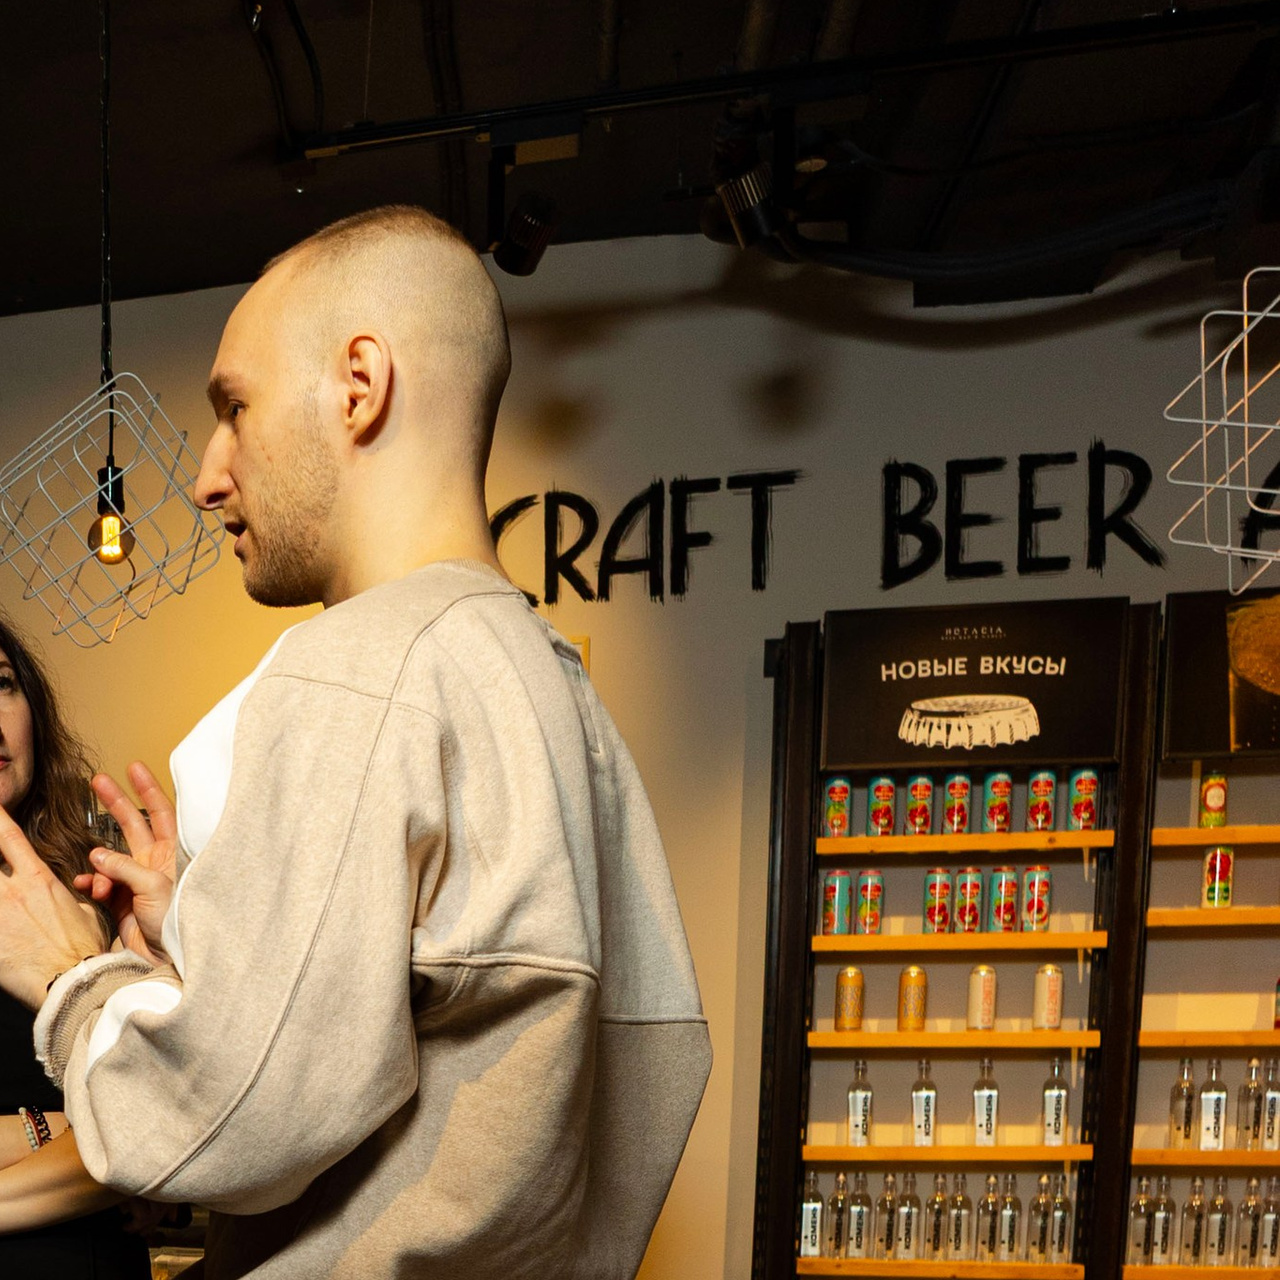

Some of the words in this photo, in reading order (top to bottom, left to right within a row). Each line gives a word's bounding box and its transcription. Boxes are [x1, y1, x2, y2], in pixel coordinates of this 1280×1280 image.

[489, 468, 805, 610] CRAFT
[880, 437, 1166, 590] BEER
[881, 657, 968, 682] НОВЫЕ
[979, 655, 1066, 676] ВКУСЫ
